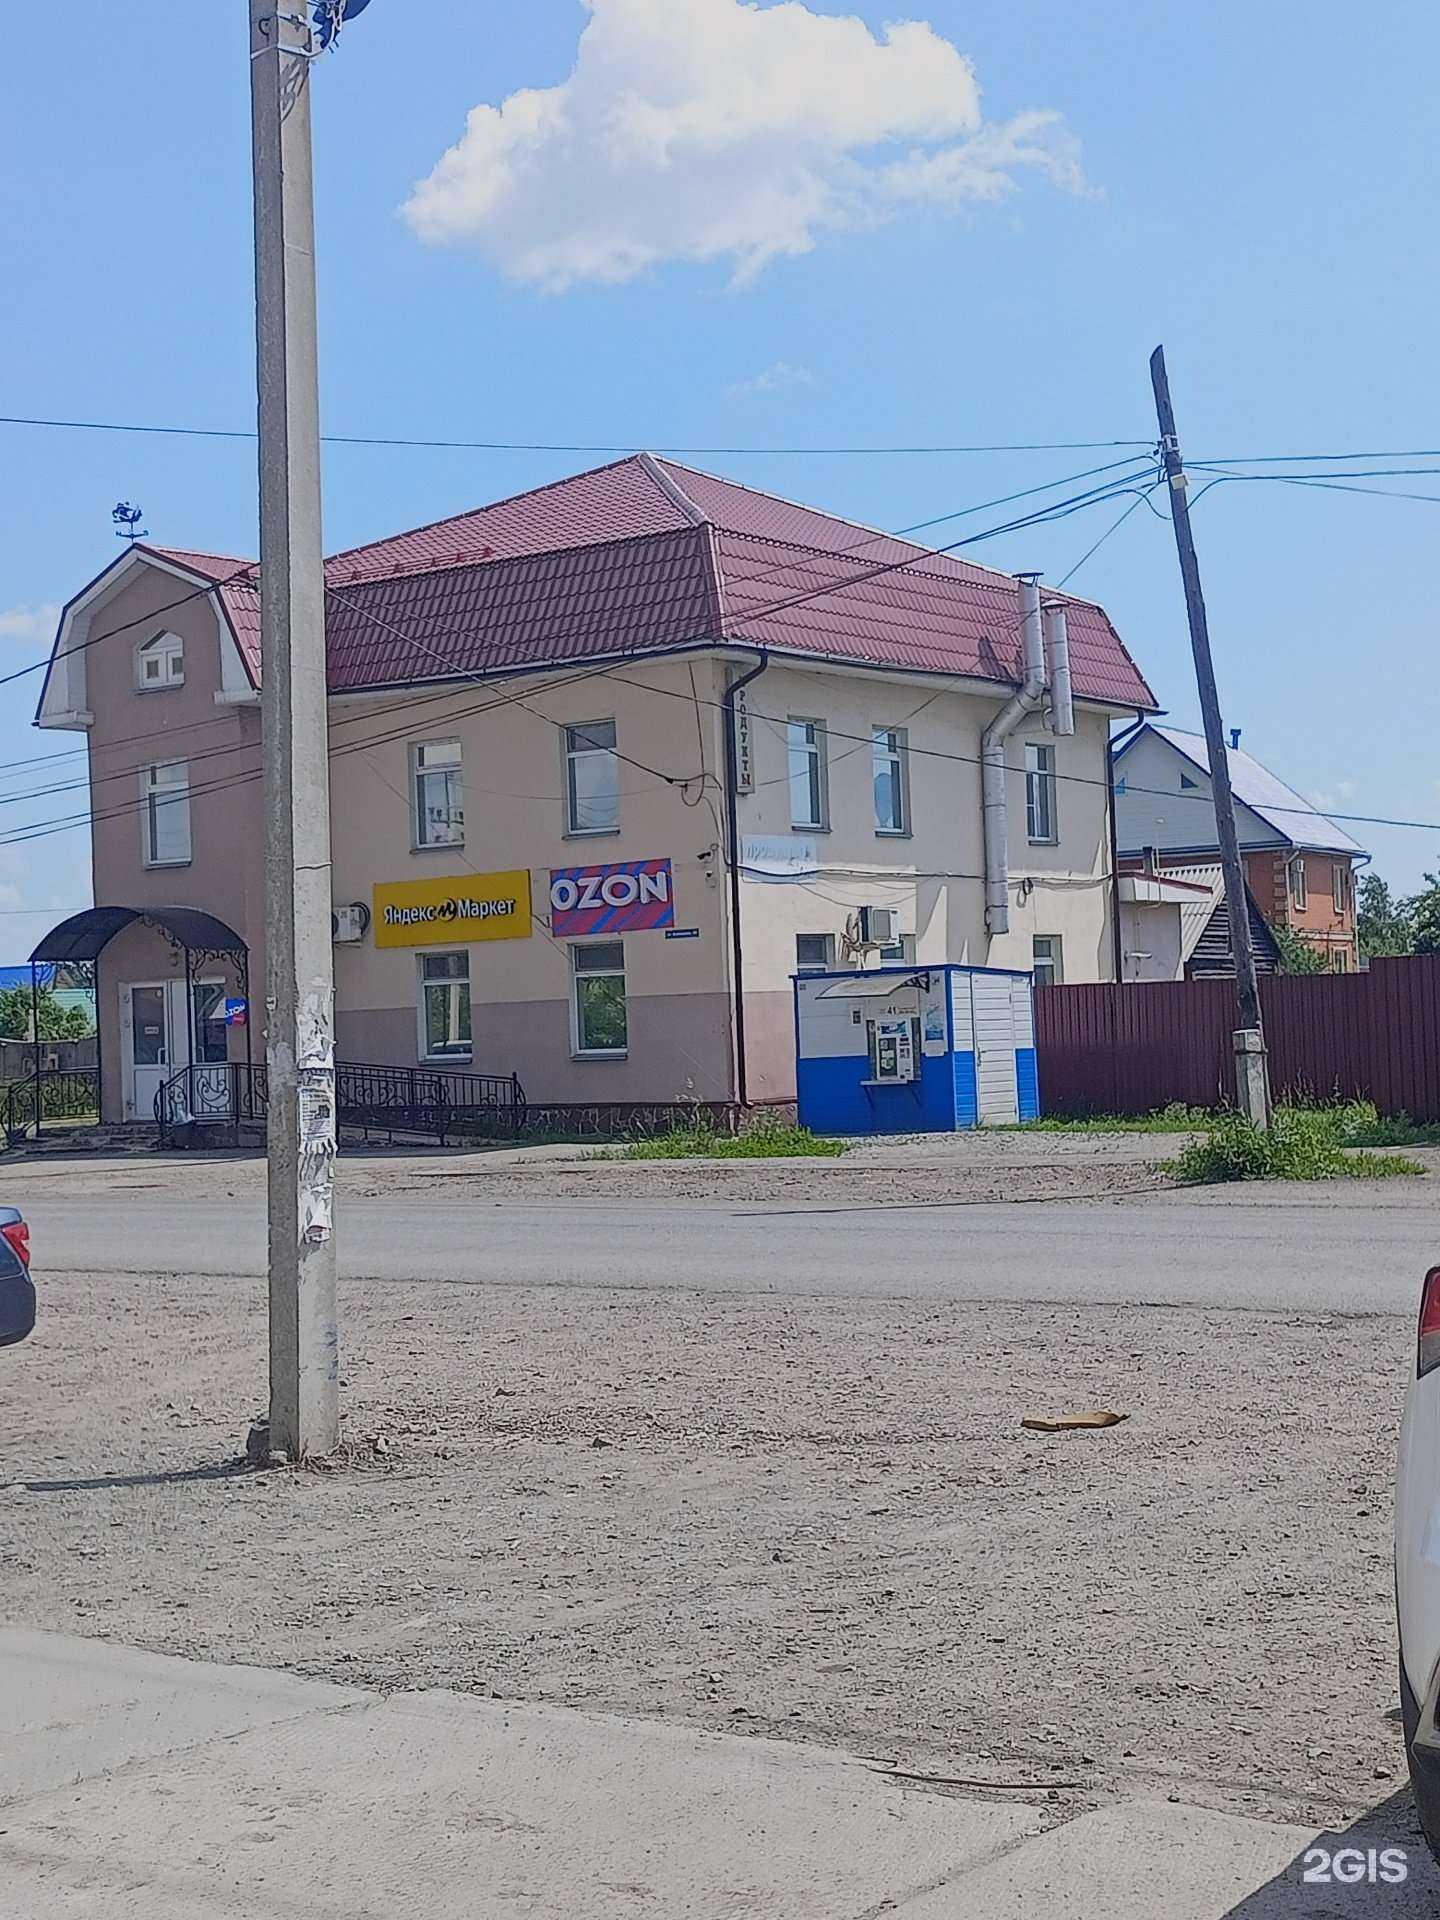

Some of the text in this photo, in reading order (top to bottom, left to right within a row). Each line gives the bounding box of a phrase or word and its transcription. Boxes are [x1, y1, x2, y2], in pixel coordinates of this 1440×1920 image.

[739, 689, 751, 785] РОДУКТЫ
[551, 872, 668, 911] OZON
[384, 898, 514, 925] Яндекс Маркет
